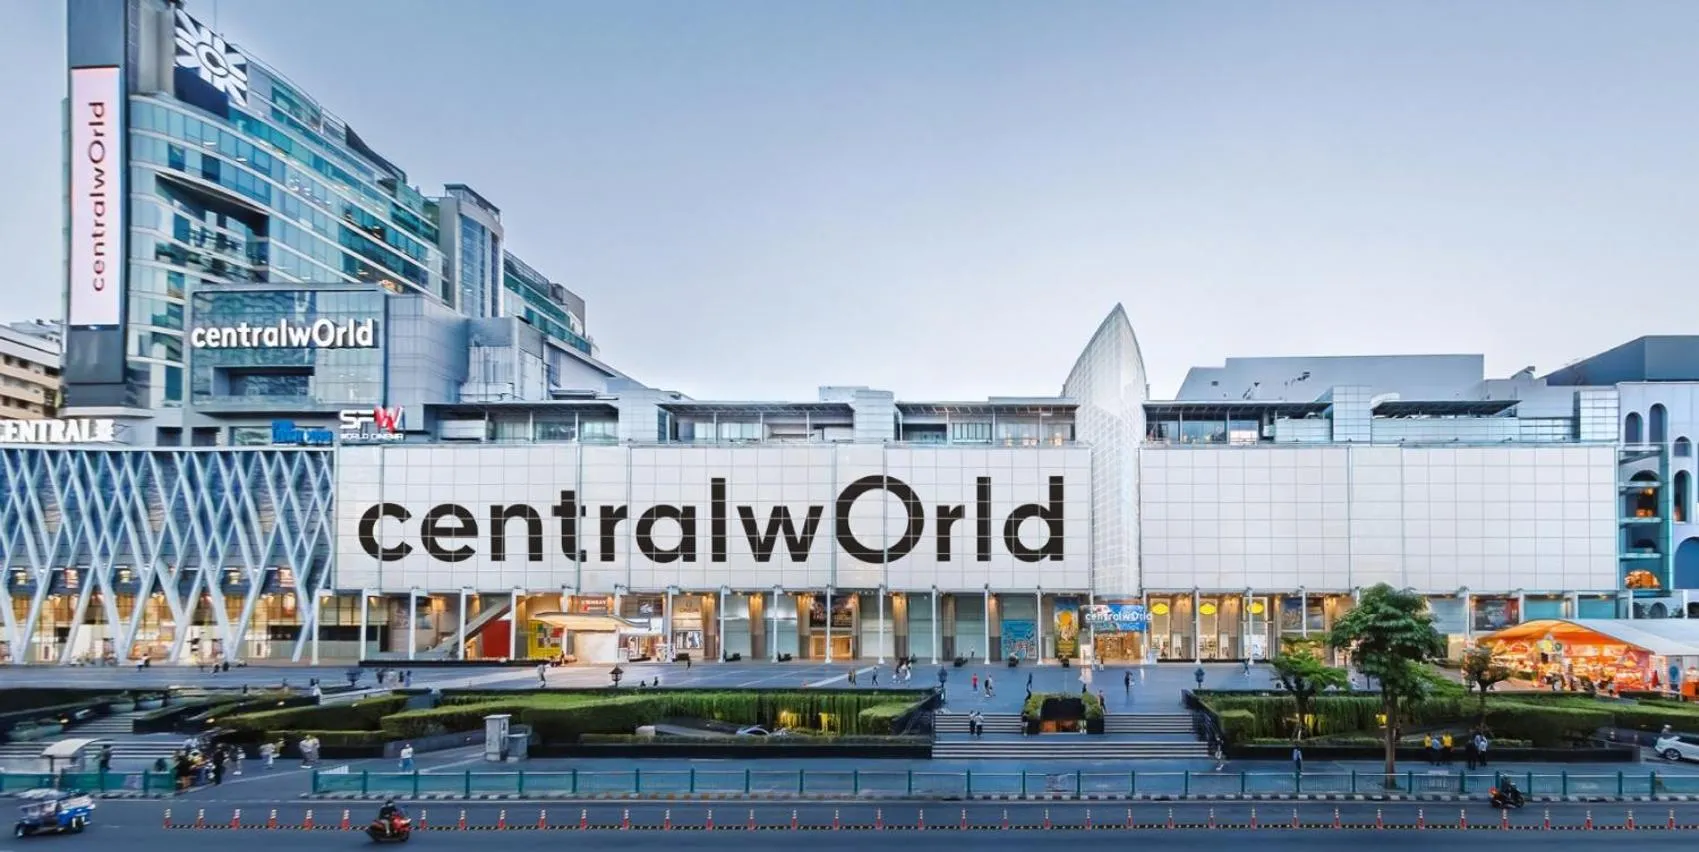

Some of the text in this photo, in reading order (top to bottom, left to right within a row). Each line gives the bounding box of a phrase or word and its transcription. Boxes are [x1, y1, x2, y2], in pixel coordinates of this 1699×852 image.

[88, 102, 106, 291] centralwOrld
[191, 318, 374, 347] centralwOrld
[358, 475, 1064, 563] centralwOrld
